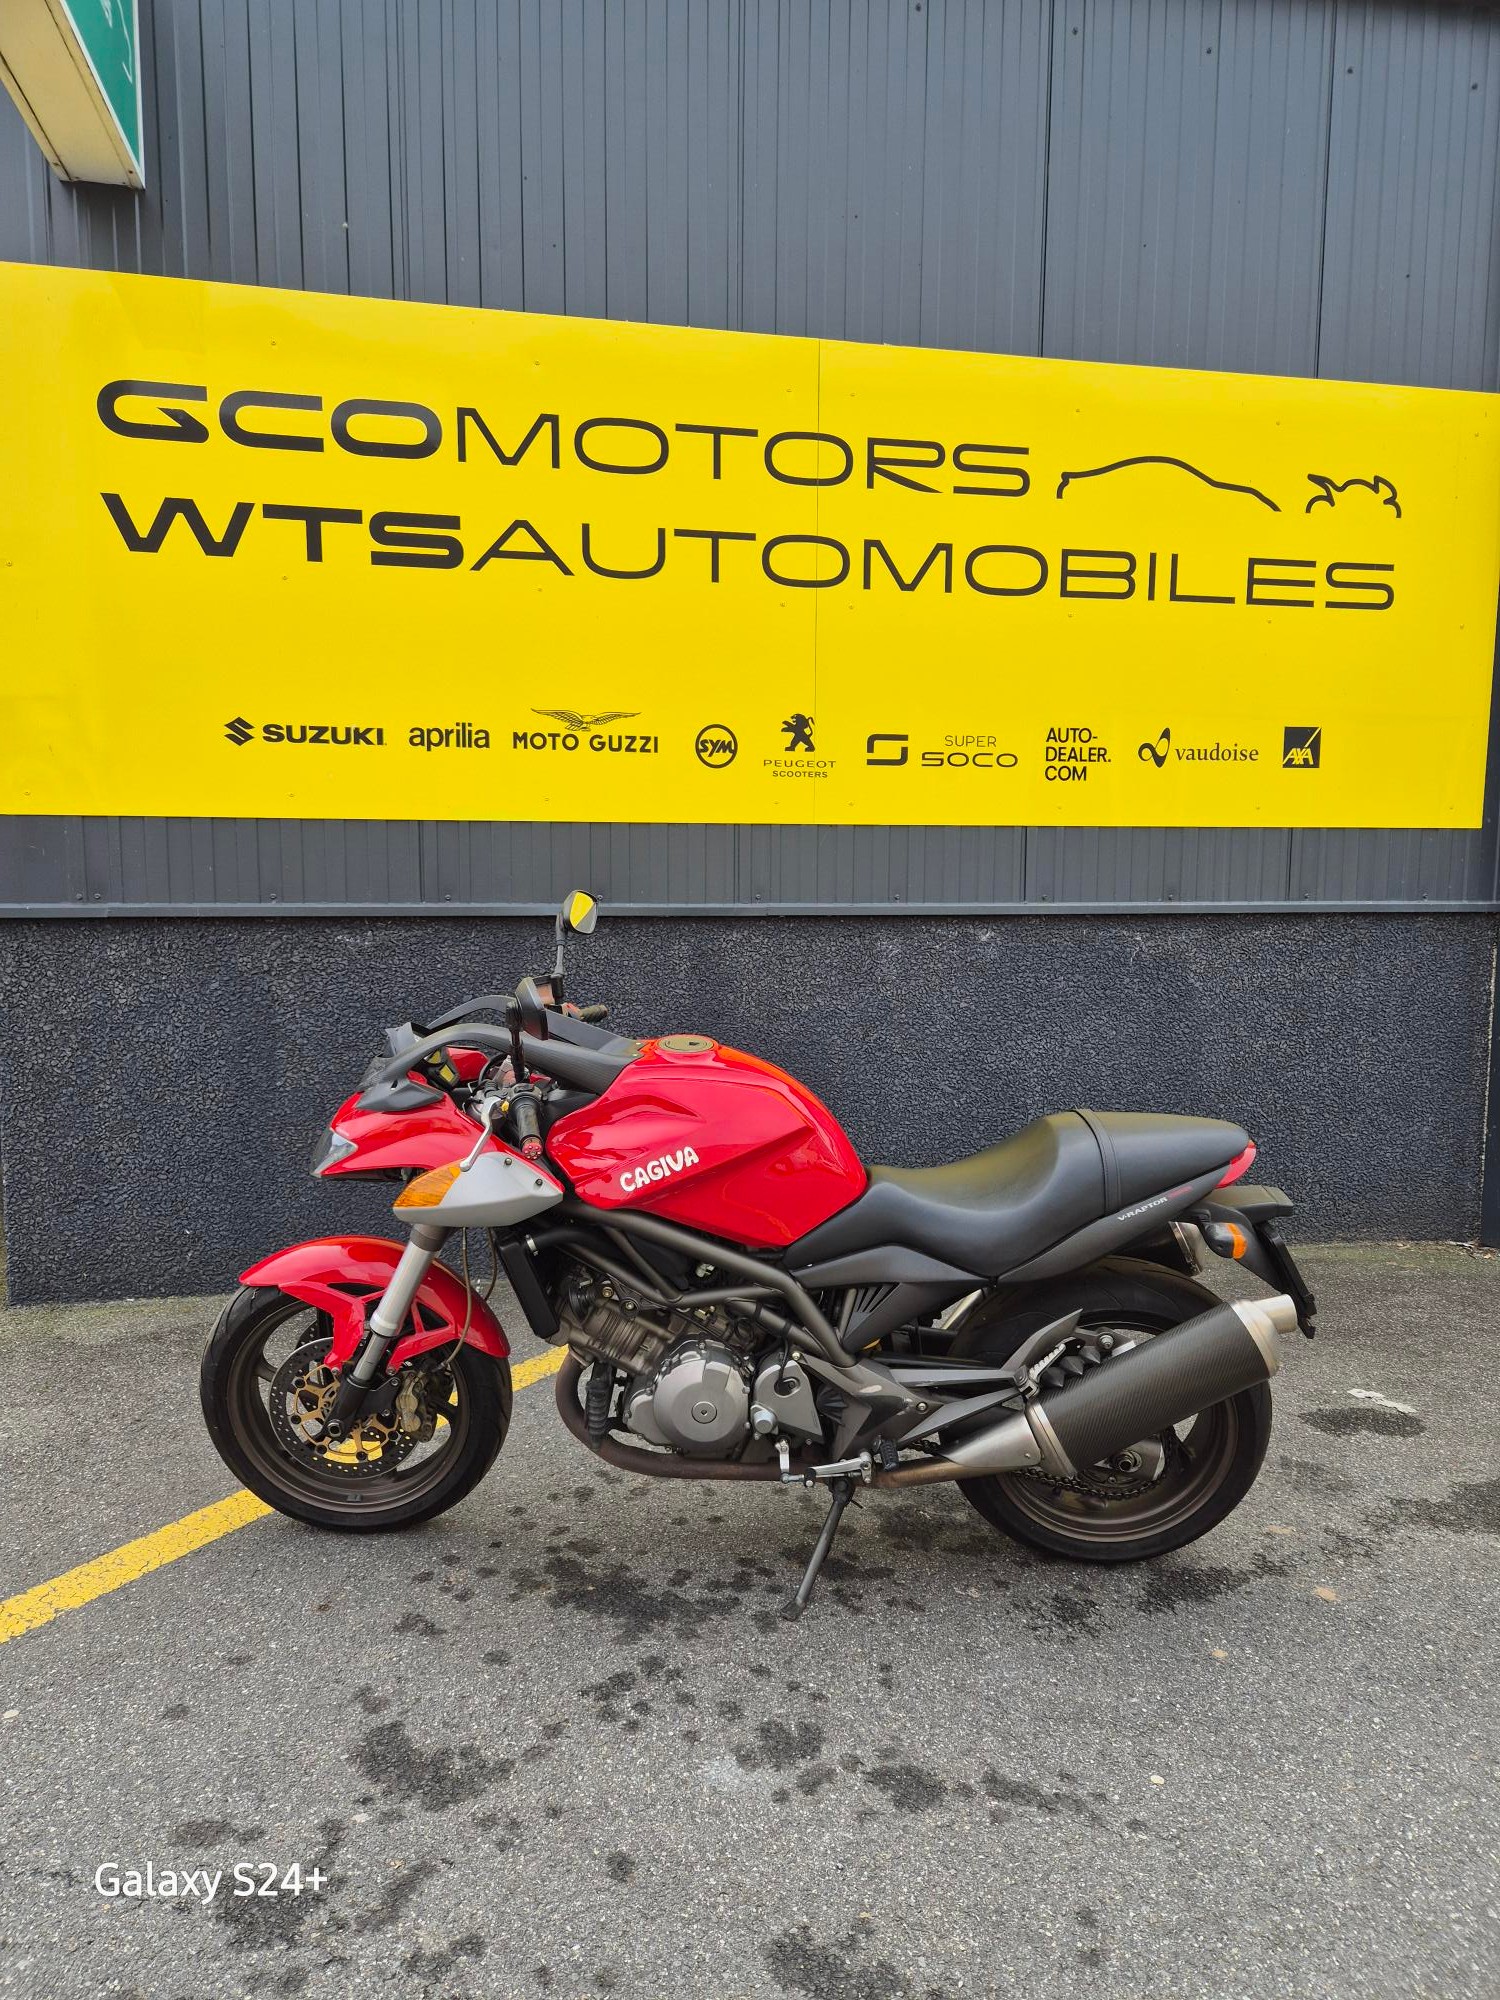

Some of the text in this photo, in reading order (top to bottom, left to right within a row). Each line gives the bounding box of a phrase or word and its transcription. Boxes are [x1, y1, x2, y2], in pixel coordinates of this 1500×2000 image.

[97, 379, 1031, 497] GCOMOTORS
[100, 492, 1396, 611] WTSAUTOMOBILES
[262, 723, 385, 746] SUZUKI
[408, 722, 491, 751] aprilia
[512, 731, 659, 754] MOTO GUZZI
[944, 735, 997, 748] SUPER
[1046, 727, 1098, 743] AUTO-
[699, 738, 735, 757] SYM
[1045, 746, 1112, 763] DEALER.
[1175, 742, 1260, 762] vaudoise
[1283, 747, 1314, 765] AXA
[763, 759, 837, 769] PEUGEOT
[921, 751, 1019, 768] SOCO
[772, 770, 829, 779] SCOOTERS
[1044, 765, 1088, 782] COM
[619, 1146, 700, 1192] CAGIVA
